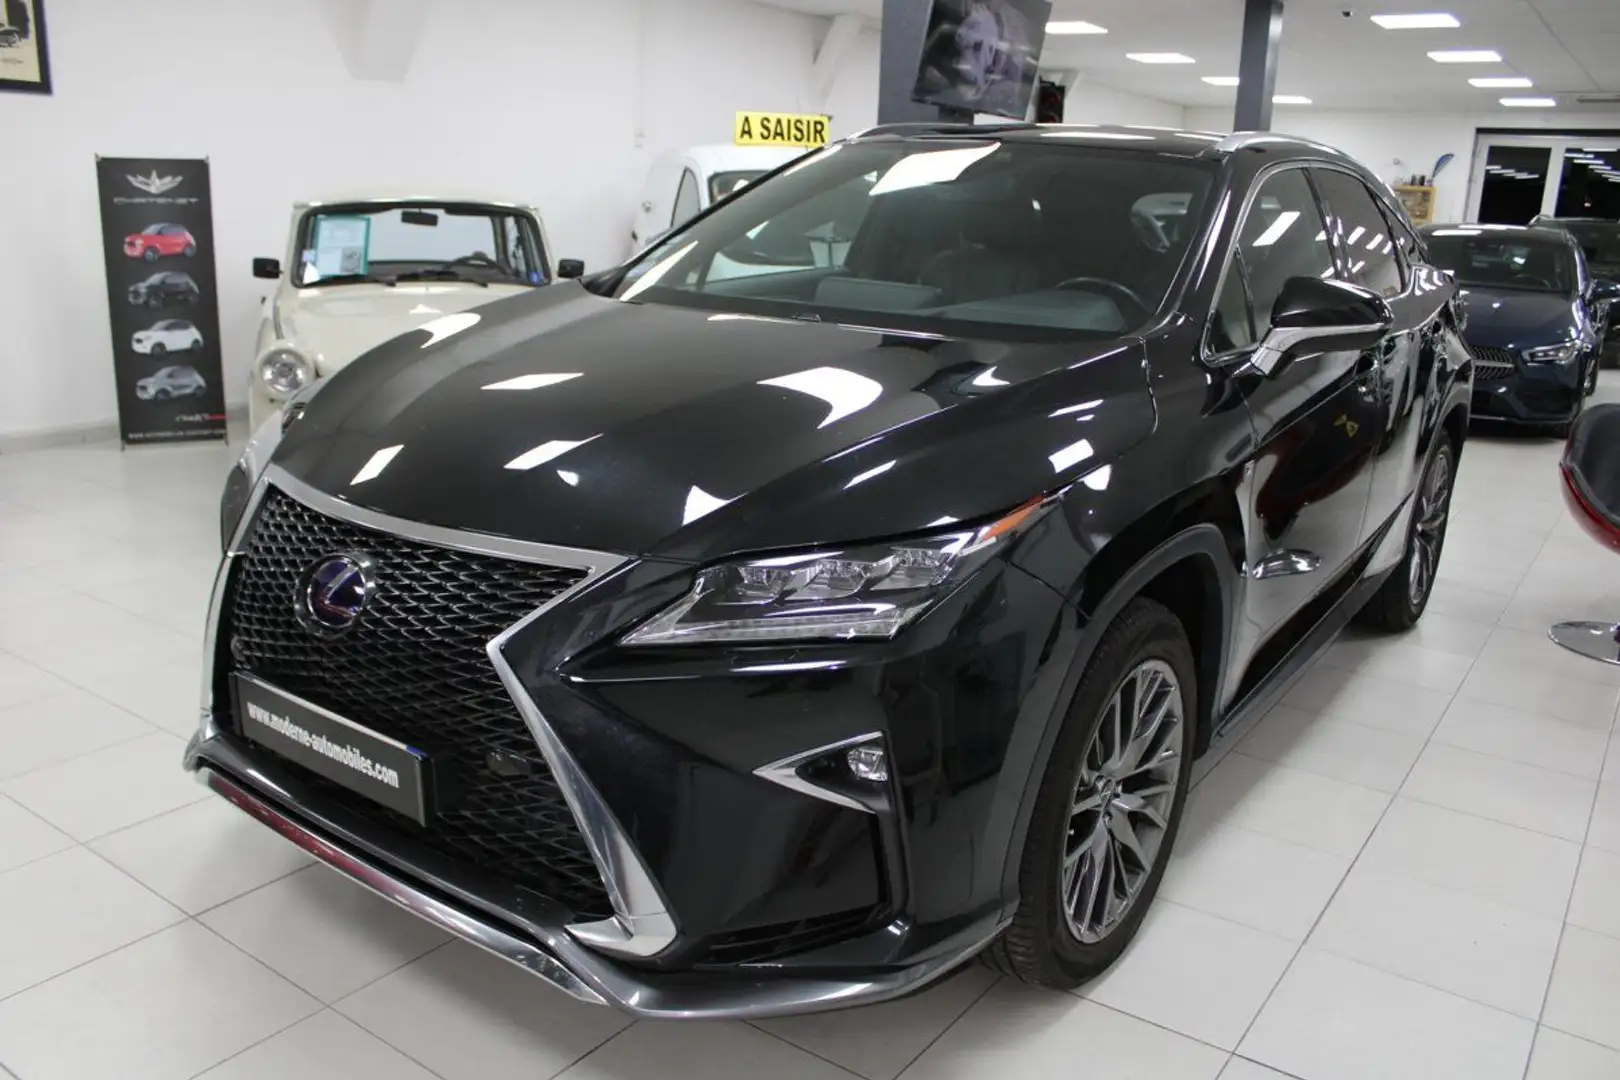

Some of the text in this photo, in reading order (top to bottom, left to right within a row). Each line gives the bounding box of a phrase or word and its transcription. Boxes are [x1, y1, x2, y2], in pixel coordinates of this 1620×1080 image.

[739, 115, 826, 144] A SAISIR
[246, 700, 401, 789] www.moderne-automobiles.com
